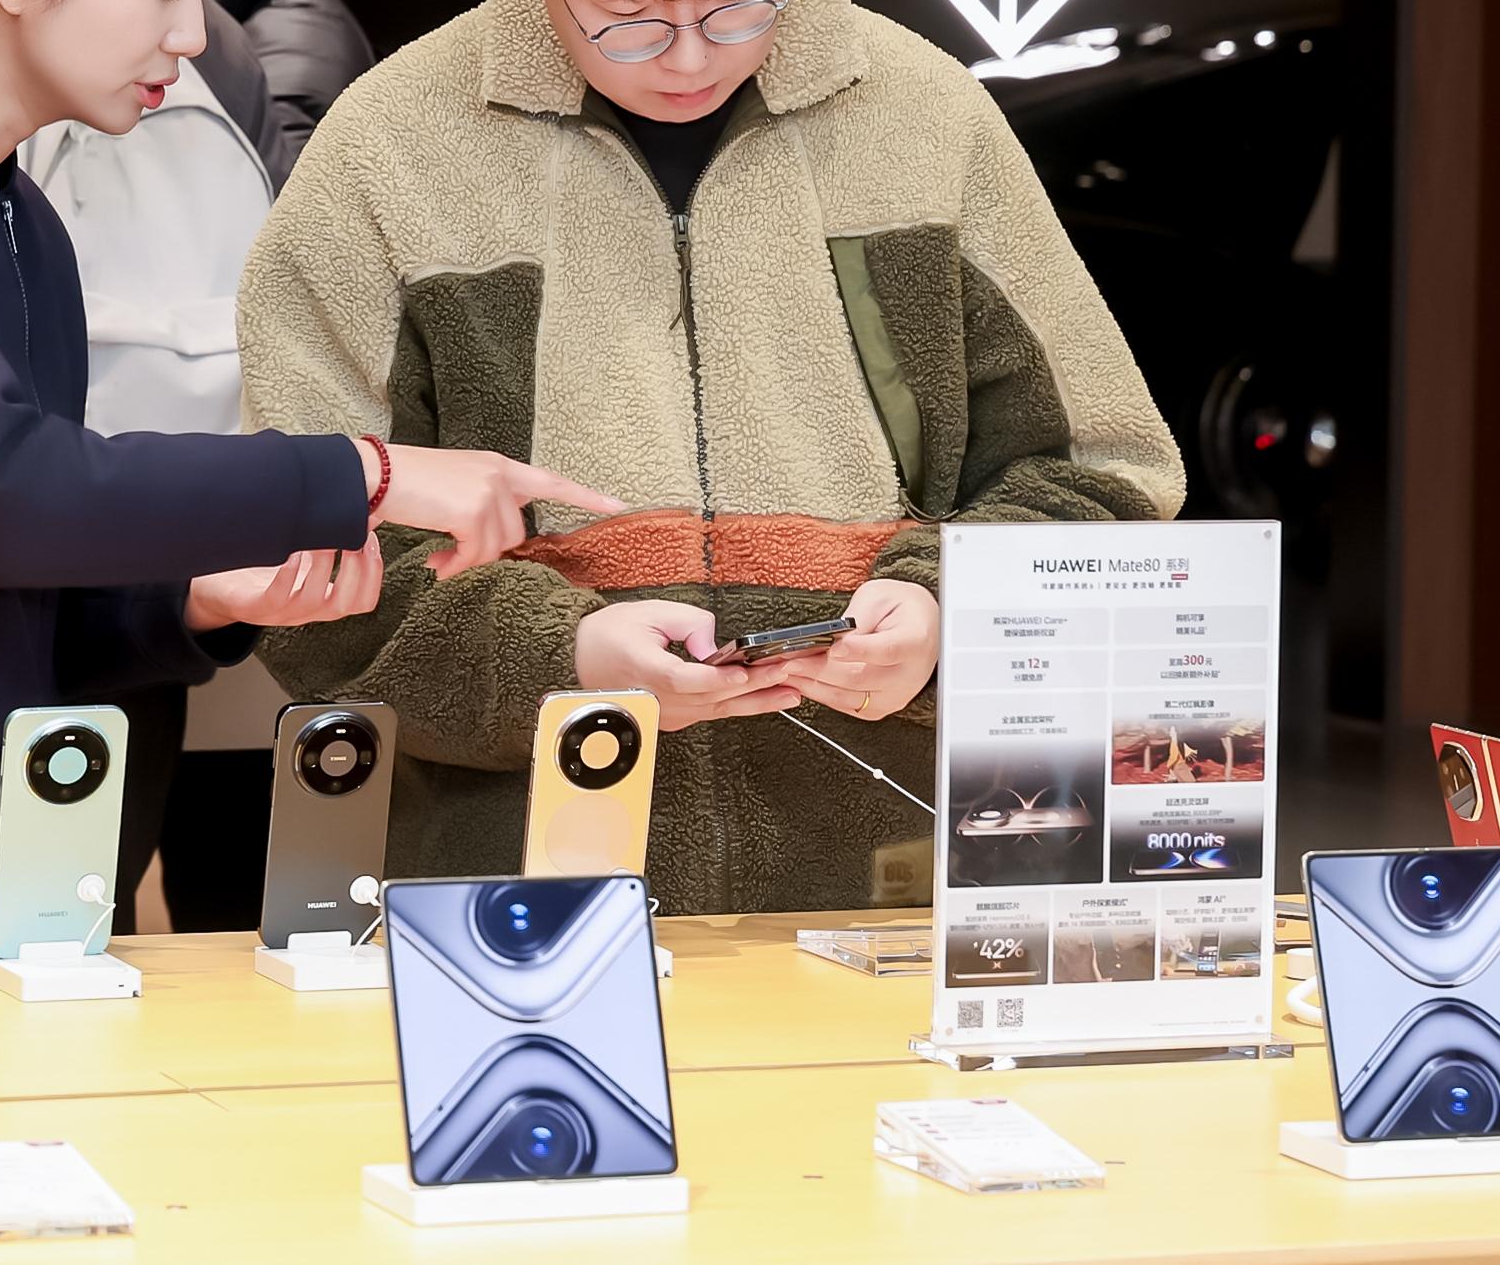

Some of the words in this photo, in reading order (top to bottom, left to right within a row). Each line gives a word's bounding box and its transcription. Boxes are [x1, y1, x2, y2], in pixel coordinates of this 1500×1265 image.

[1033, 559, 1101, 573] HUAWEI
[1108, 558, 1161, 572] Mate80
[1165, 557, 1190, 572] 系列
[1028, 658, 1040, 669] 12
[1147, 832, 1192, 849] 8000
[1193, 831, 1226, 848] nits
